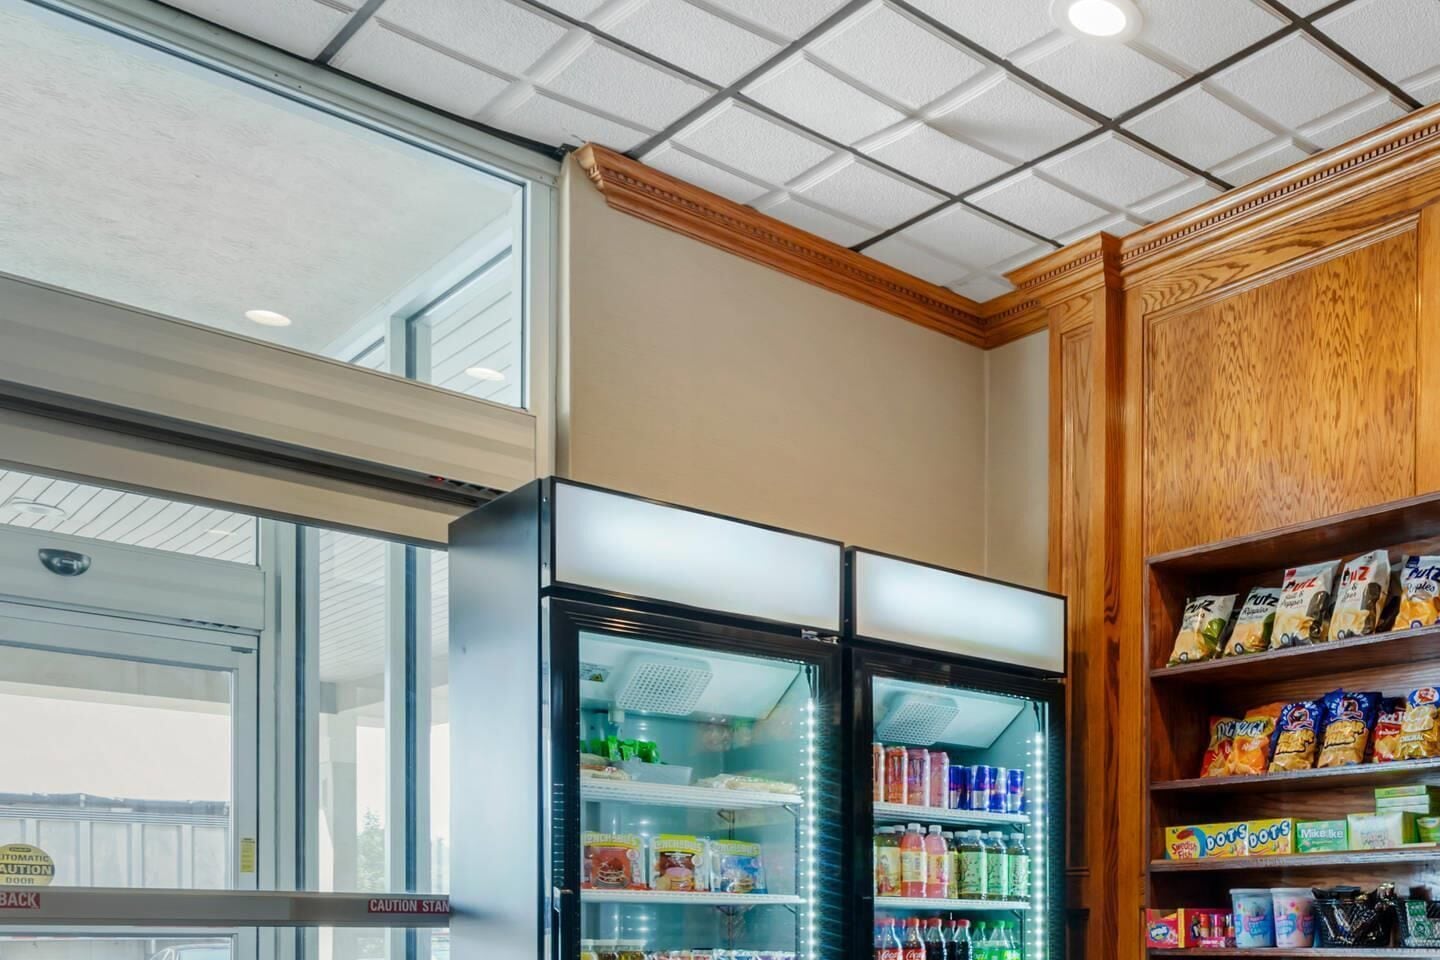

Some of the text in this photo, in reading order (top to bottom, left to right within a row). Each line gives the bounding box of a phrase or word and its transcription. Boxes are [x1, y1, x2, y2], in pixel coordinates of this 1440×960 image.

[1206, 824, 1247, 851] DOTS
[1249, 820, 1291, 848] DOTS
[370, 899, 418, 912] CAUTION
